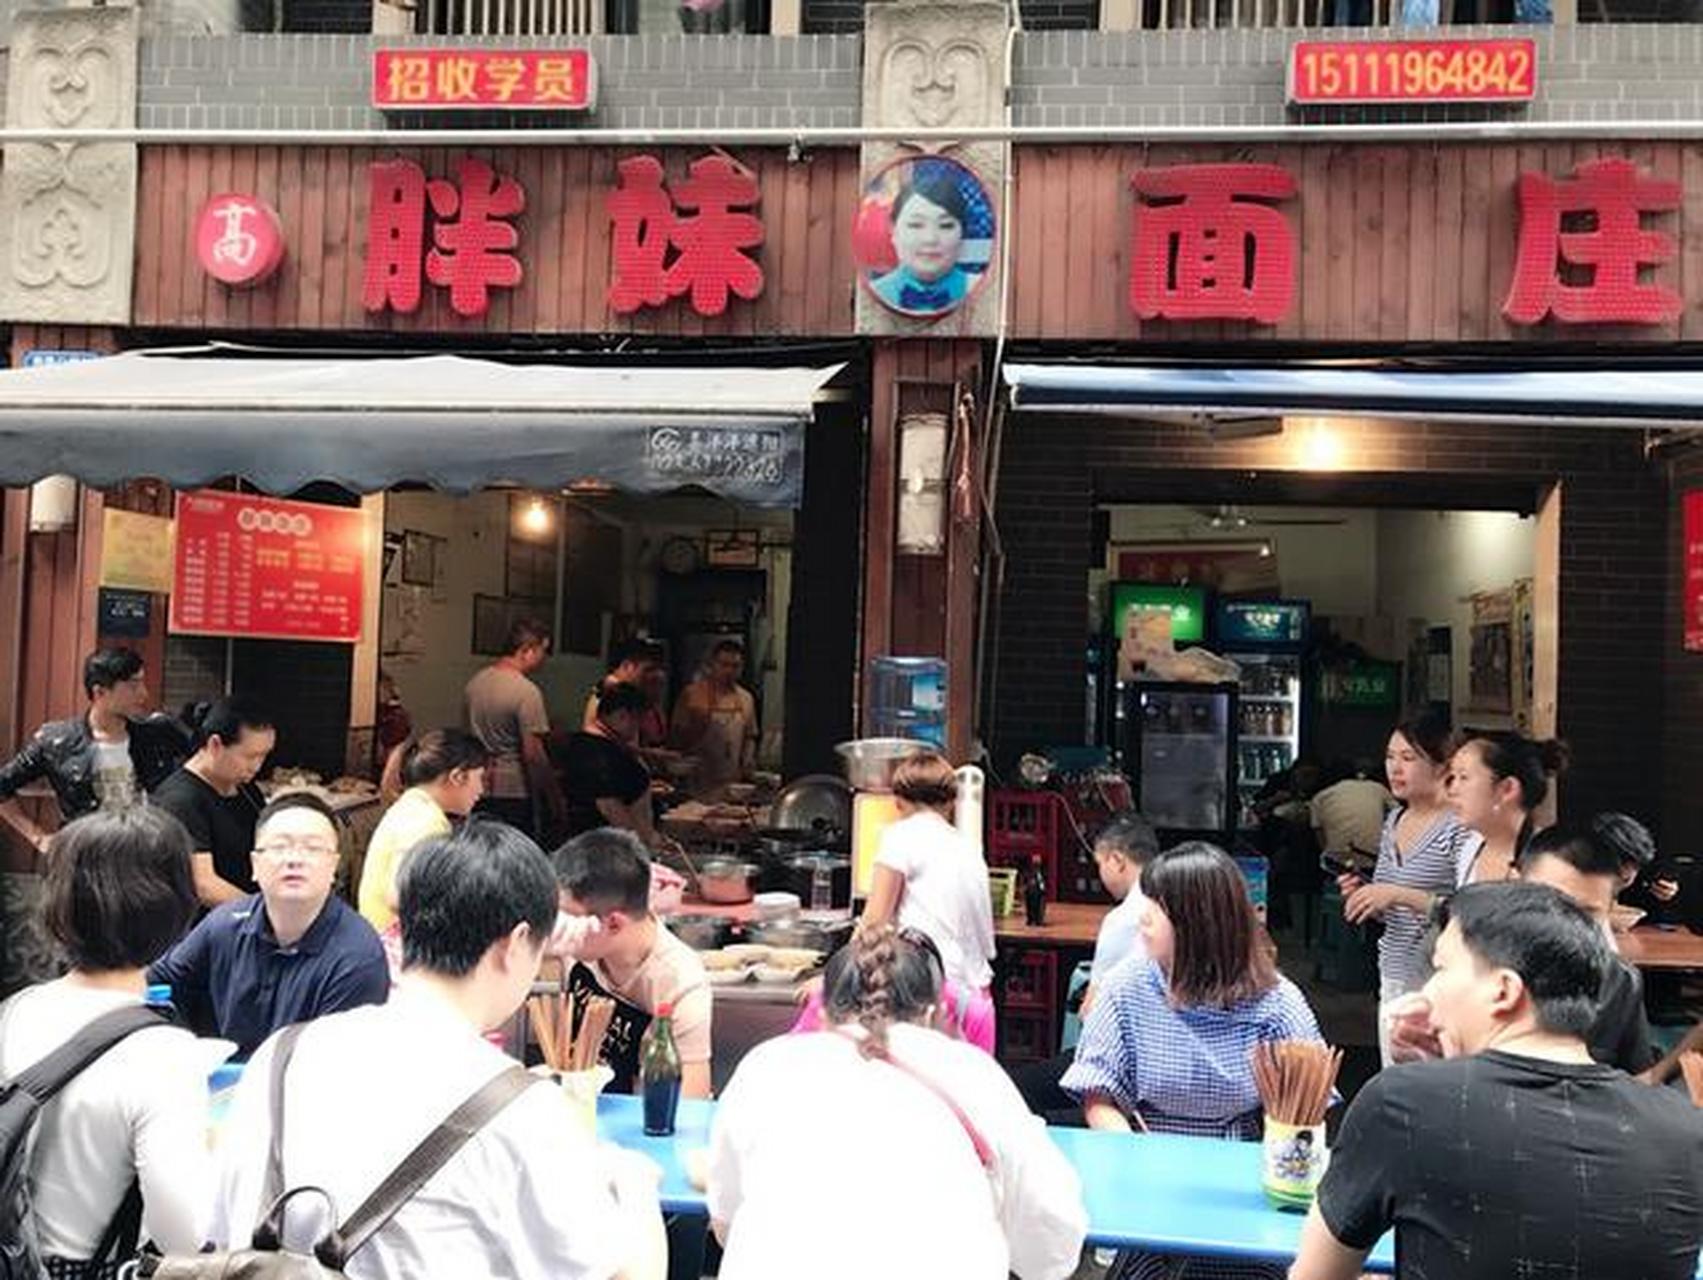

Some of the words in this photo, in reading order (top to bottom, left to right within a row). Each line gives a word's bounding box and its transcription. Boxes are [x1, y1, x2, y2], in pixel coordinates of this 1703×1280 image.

[388, 58, 577, 103] 招收学员
[1303, 50, 1530, 94] 15111964842
[213, 203, 257, 265] 高
